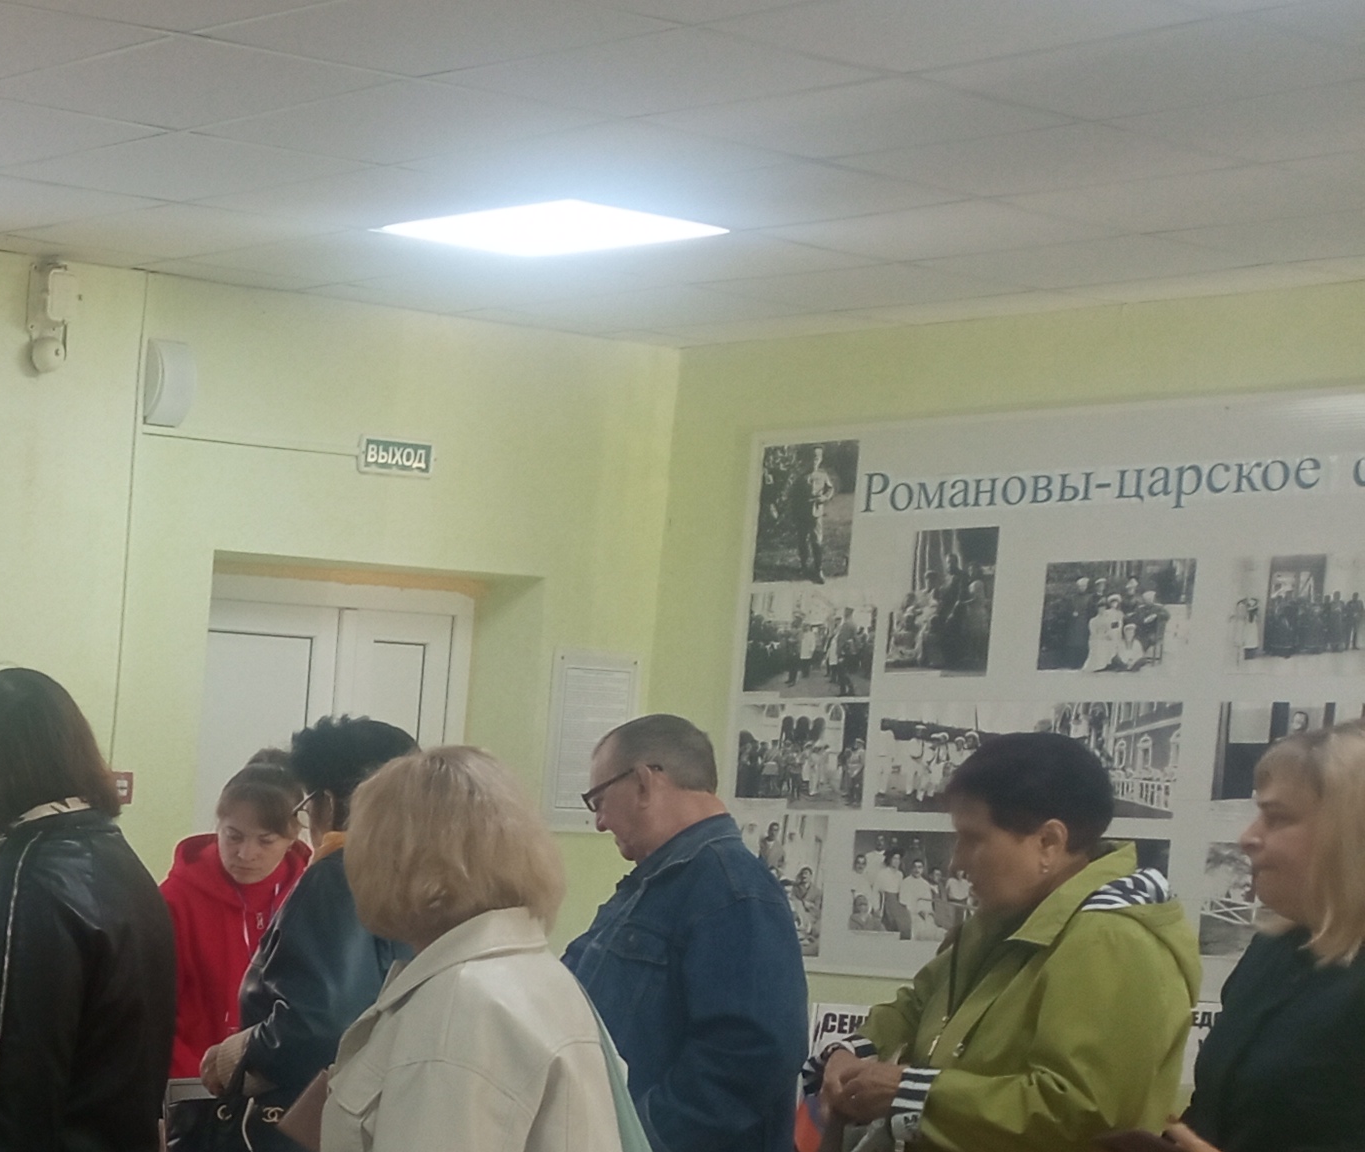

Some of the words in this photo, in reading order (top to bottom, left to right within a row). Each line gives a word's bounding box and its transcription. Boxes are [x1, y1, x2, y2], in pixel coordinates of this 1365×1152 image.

[366, 444, 426, 469] ВЫХОД
[860, 457, 1321, 513] Романовы-царское
[821, 1012, 869, 1035] СЕН
